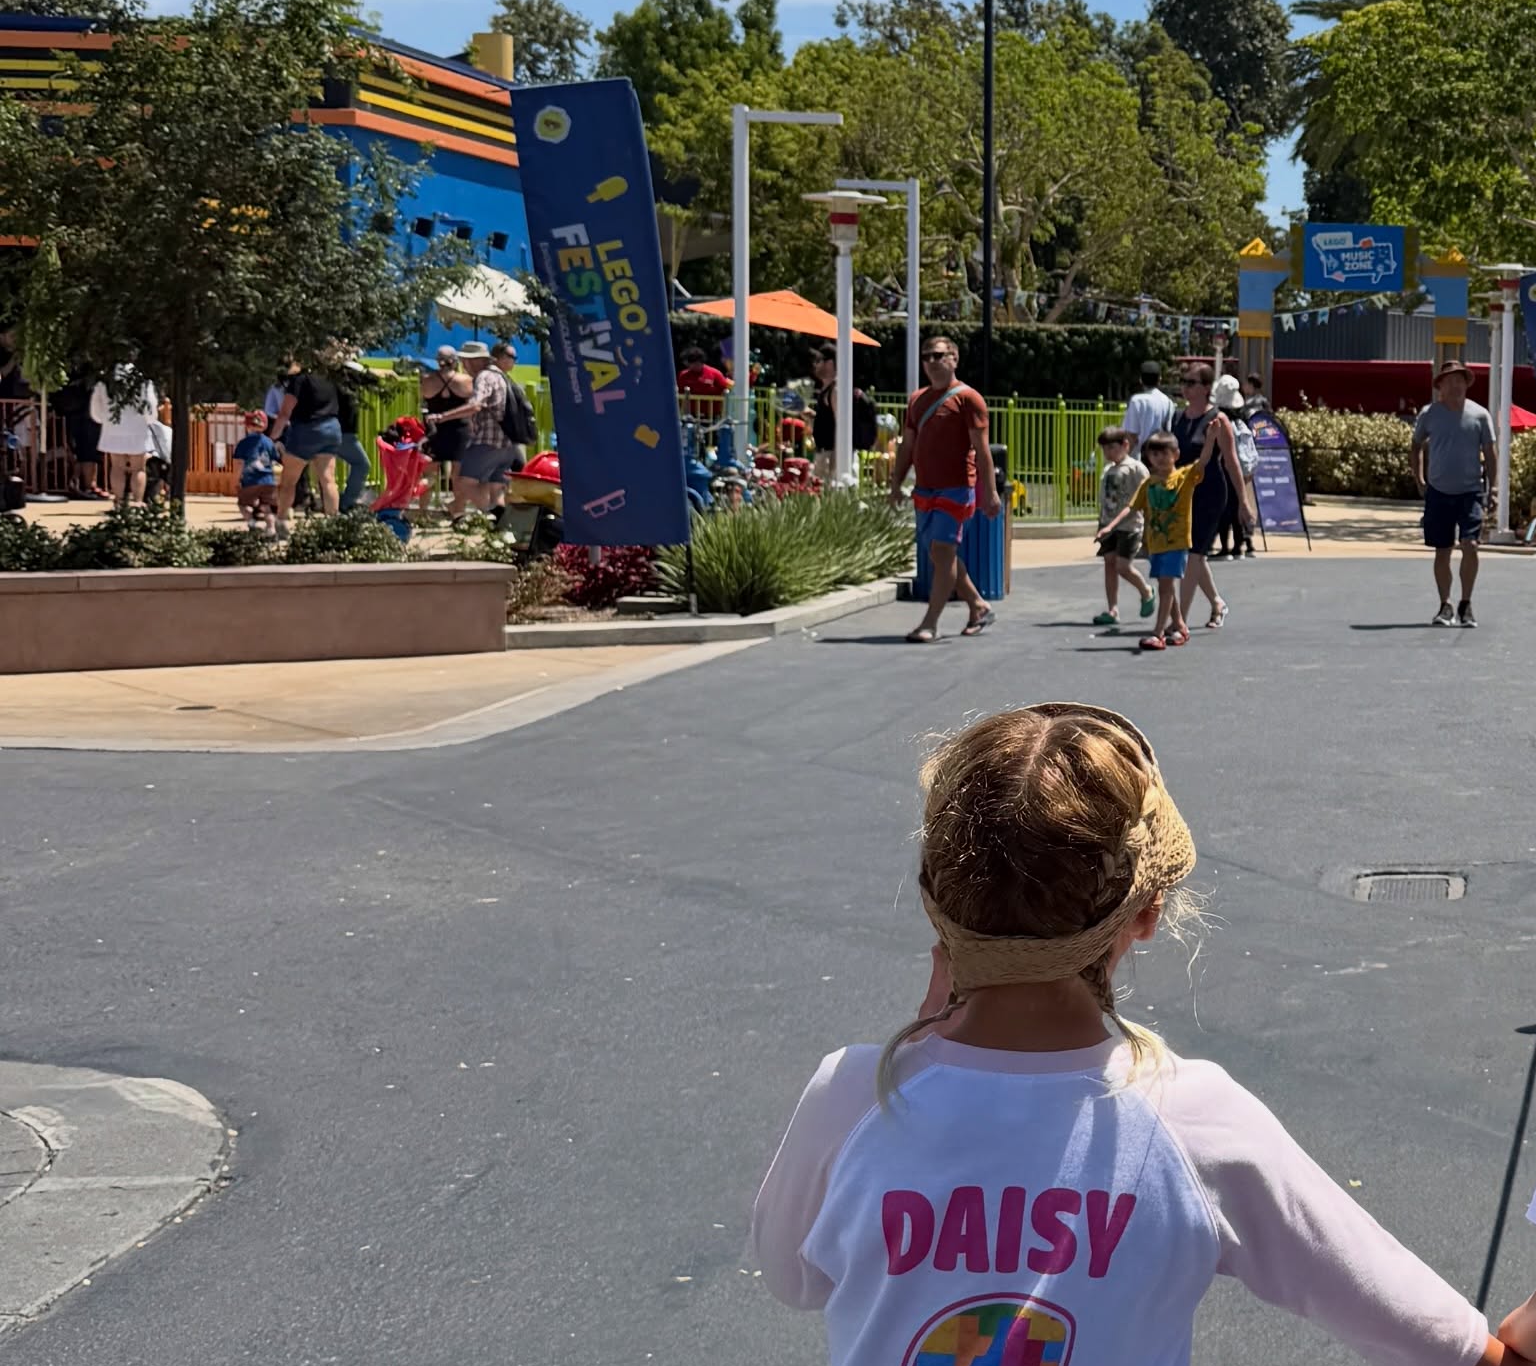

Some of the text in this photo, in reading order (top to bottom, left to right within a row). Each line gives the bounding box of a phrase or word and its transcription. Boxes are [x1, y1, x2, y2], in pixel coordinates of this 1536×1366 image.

[595, 239, 649, 332] LEGO
[1342, 251, 1375, 261] MUSIC
[1344, 261, 1373, 270] ZONE
[551, 223, 626, 414] FESTIVAL
[881, 1186, 1137, 1278] DAISY
